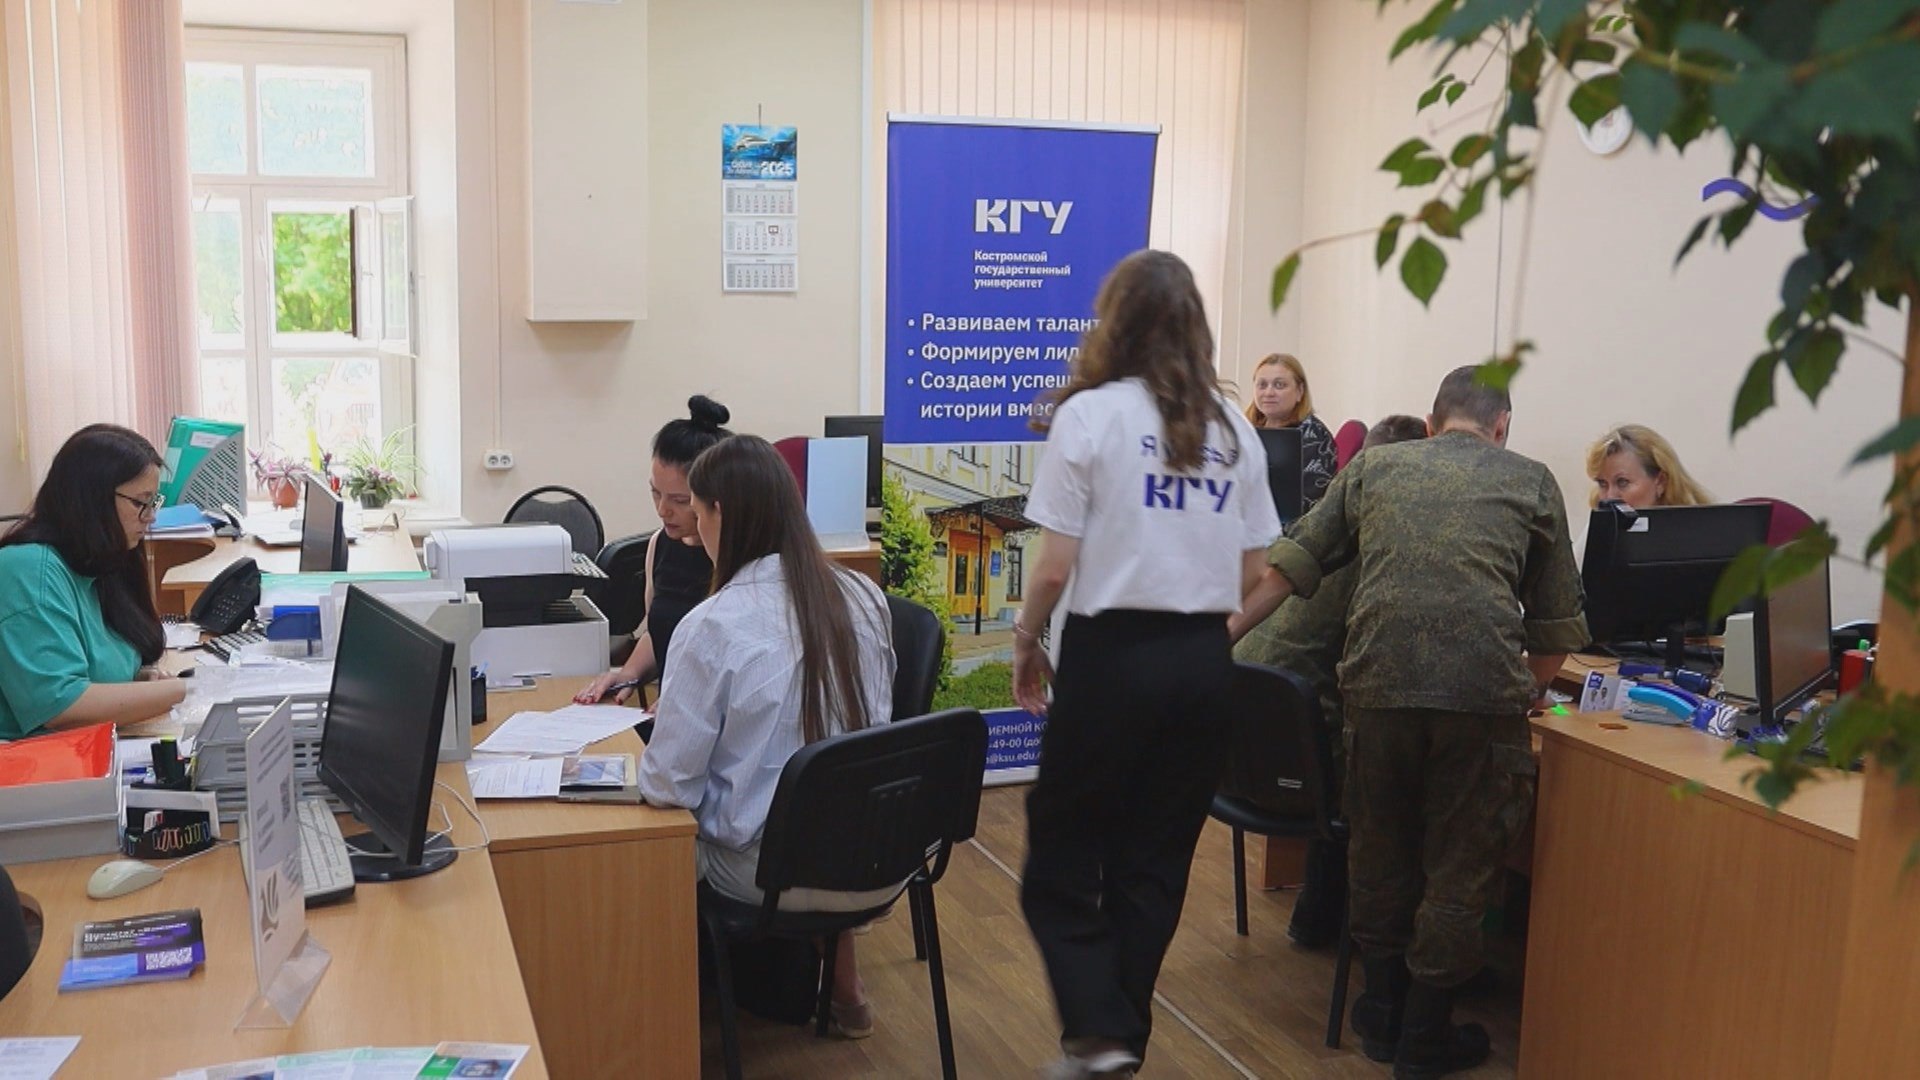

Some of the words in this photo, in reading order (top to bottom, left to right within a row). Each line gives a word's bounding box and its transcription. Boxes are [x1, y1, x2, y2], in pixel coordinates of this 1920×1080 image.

[759, 160, 795, 177] 2025
[975, 199, 1074, 234] КГУ
[974, 249, 1048, 263] Костромской
[974, 264, 1071, 277] государственный
[974, 279, 1044, 290] университет
[922, 313, 1031, 332] Развиваем
[921, 341, 1039, 364] Формируем
[920, 371, 1006, 392] Создаем
[920, 402, 1002, 422] истории
[1144, 473, 1232, 513] КГУ
